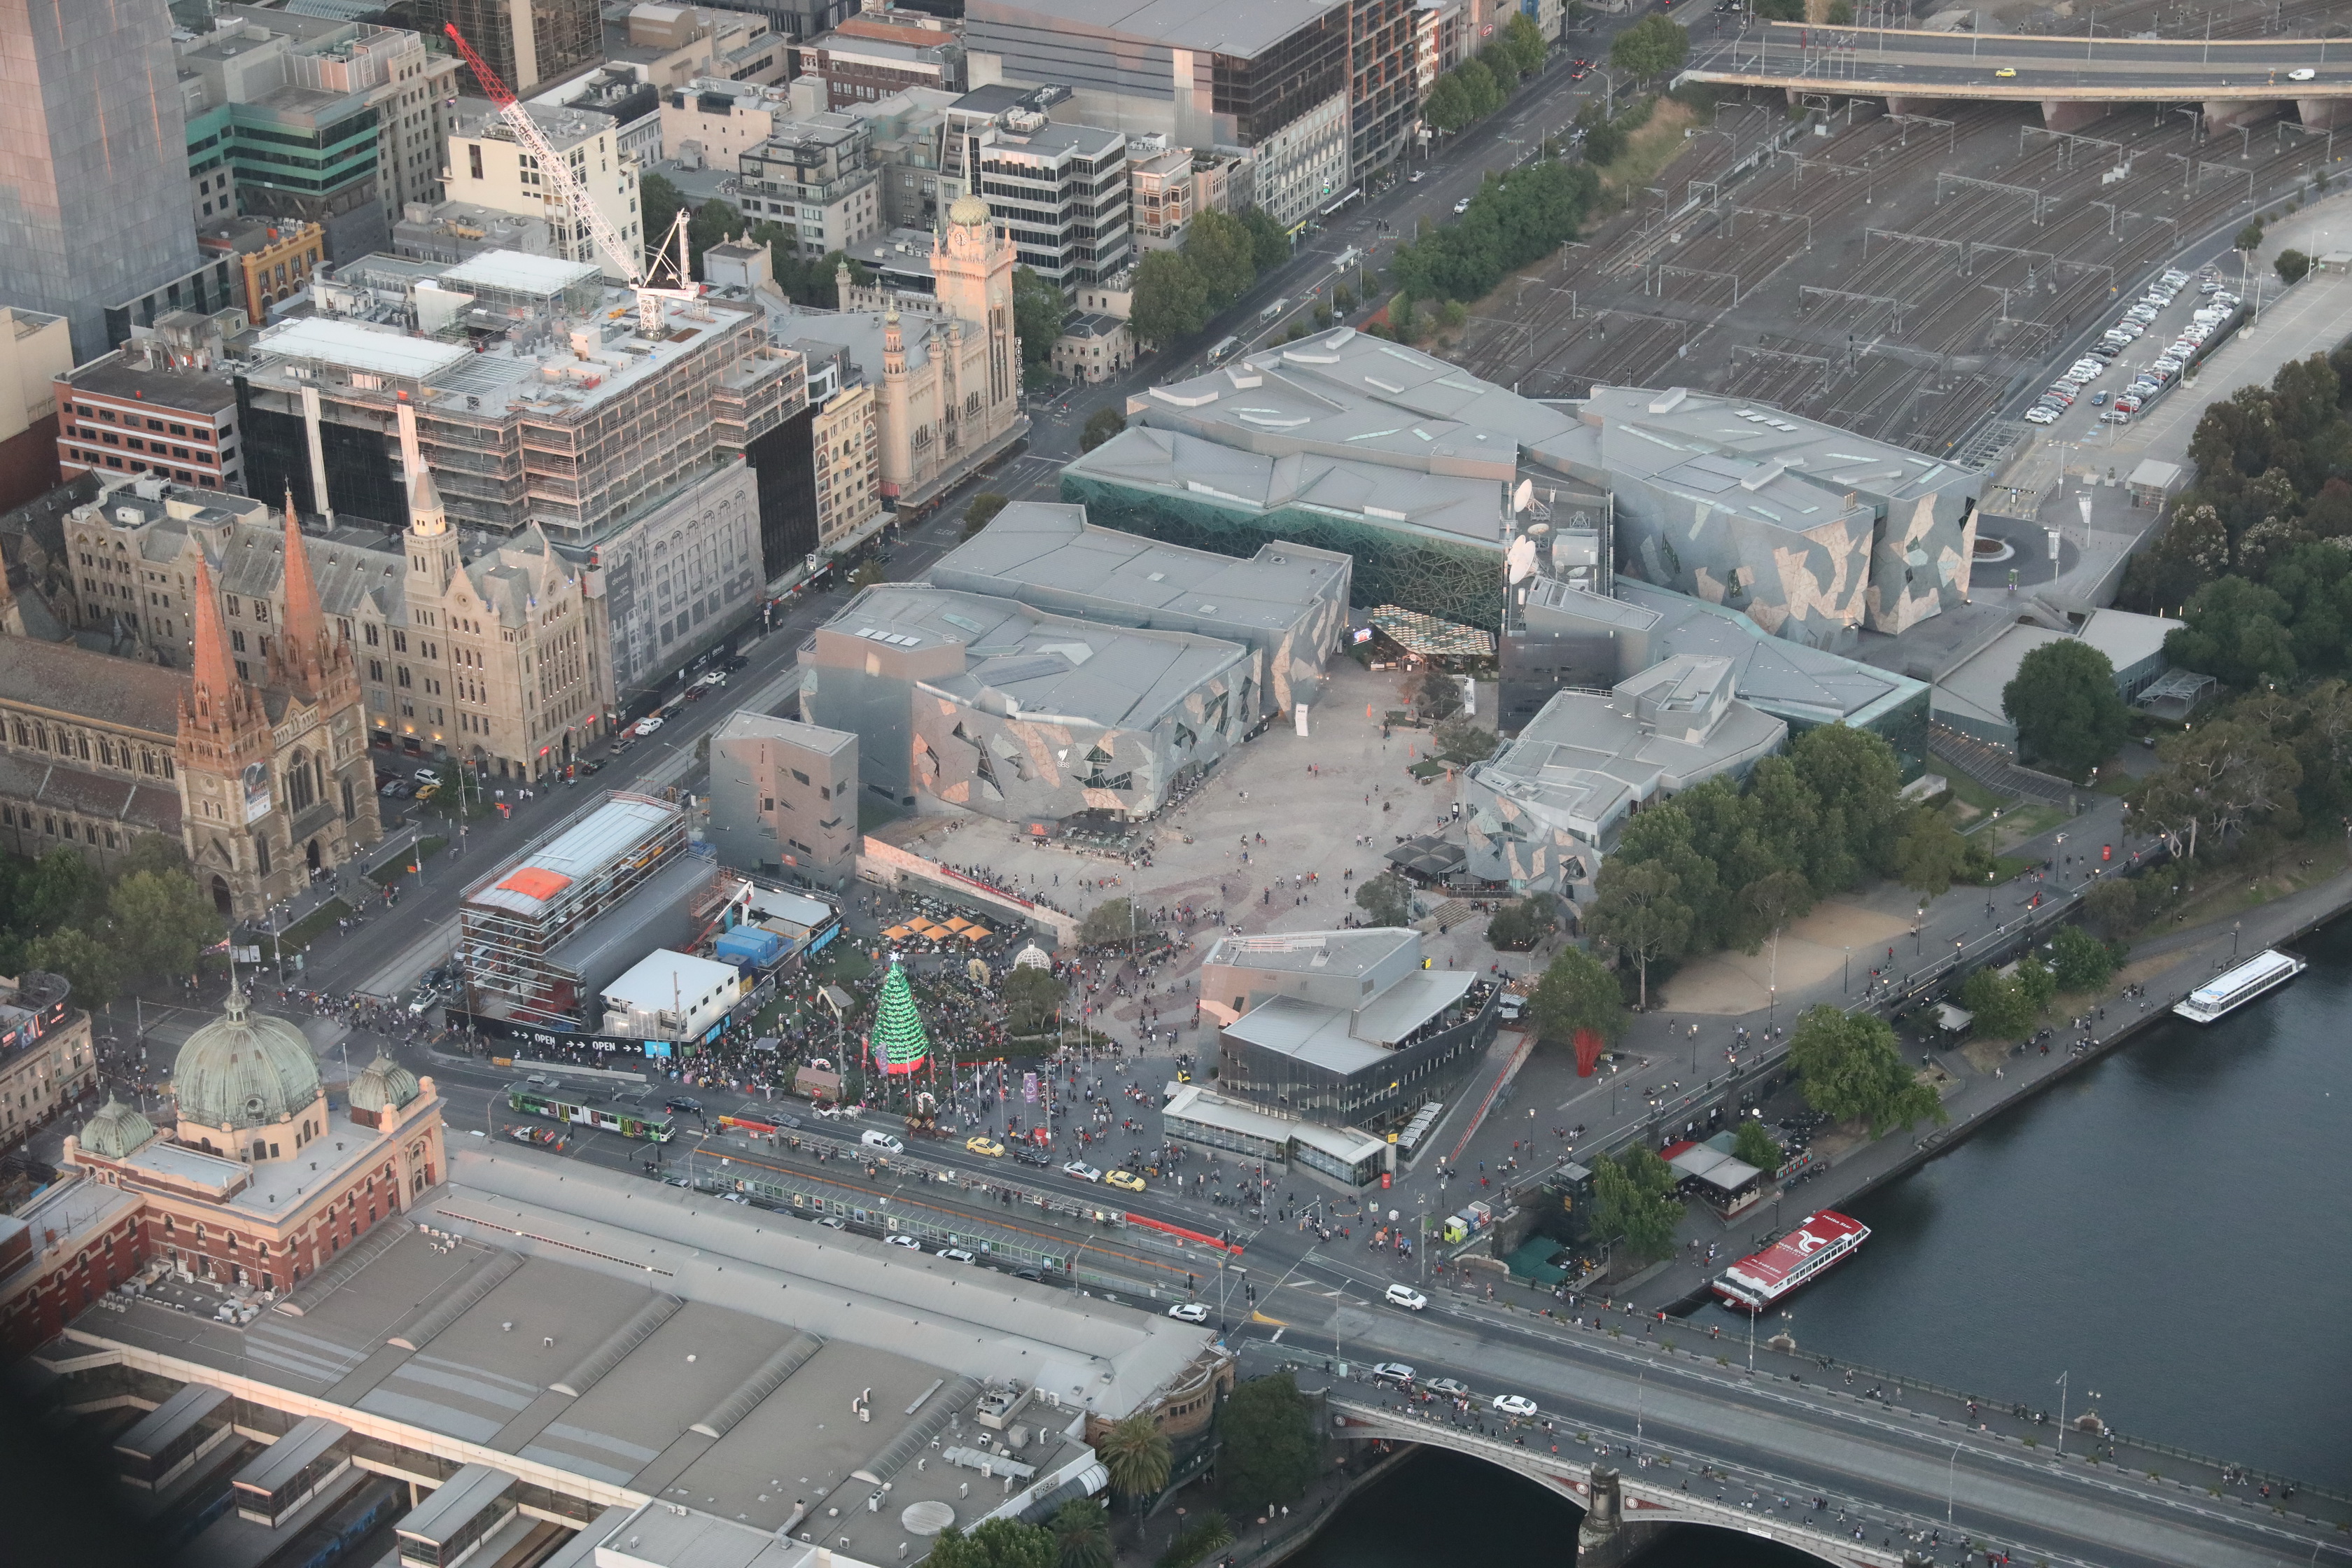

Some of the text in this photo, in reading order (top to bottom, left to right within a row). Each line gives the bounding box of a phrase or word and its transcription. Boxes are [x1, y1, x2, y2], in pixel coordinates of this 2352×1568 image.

[519, 126, 547, 161] dexus
[612, 572, 628, 586] dexus
[712, 645, 724, 655] dexus
[248, 796, 270, 811] REFUGEES
[249, 790, 268, 805] WELCOME
[534, 1033, 555, 1045] OPEN
[592, 1041, 616, 1051] OPEN
